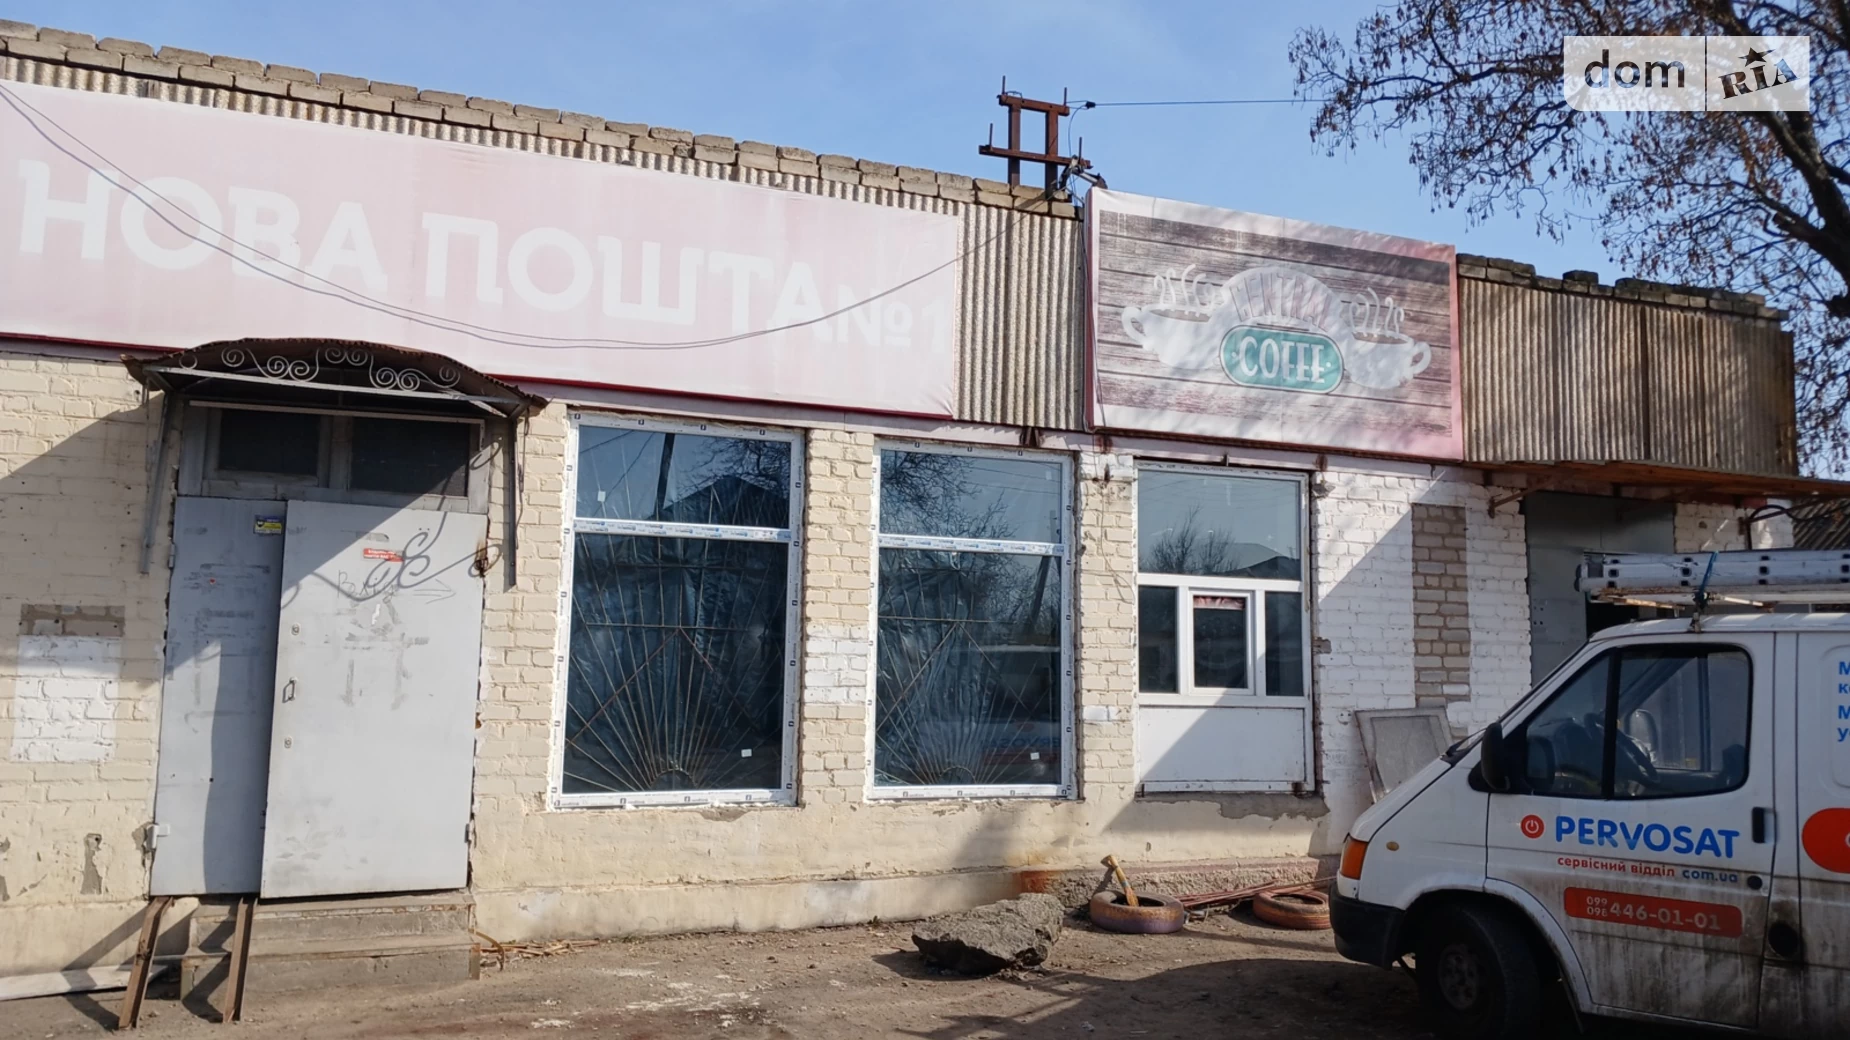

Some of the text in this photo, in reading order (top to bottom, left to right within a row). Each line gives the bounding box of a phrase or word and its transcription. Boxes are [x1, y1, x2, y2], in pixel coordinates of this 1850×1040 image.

[18, 158, 388, 293] НОВА
[422, 211, 833, 344] ПОШТА
[1556, 816, 1740, 858] PERVOSAT
[1557, 856, 1675, 877] сервісний відділ
[1682, 868, 1738, 883] com.ua
[1610, 902, 1721, 930] 446-01-01
